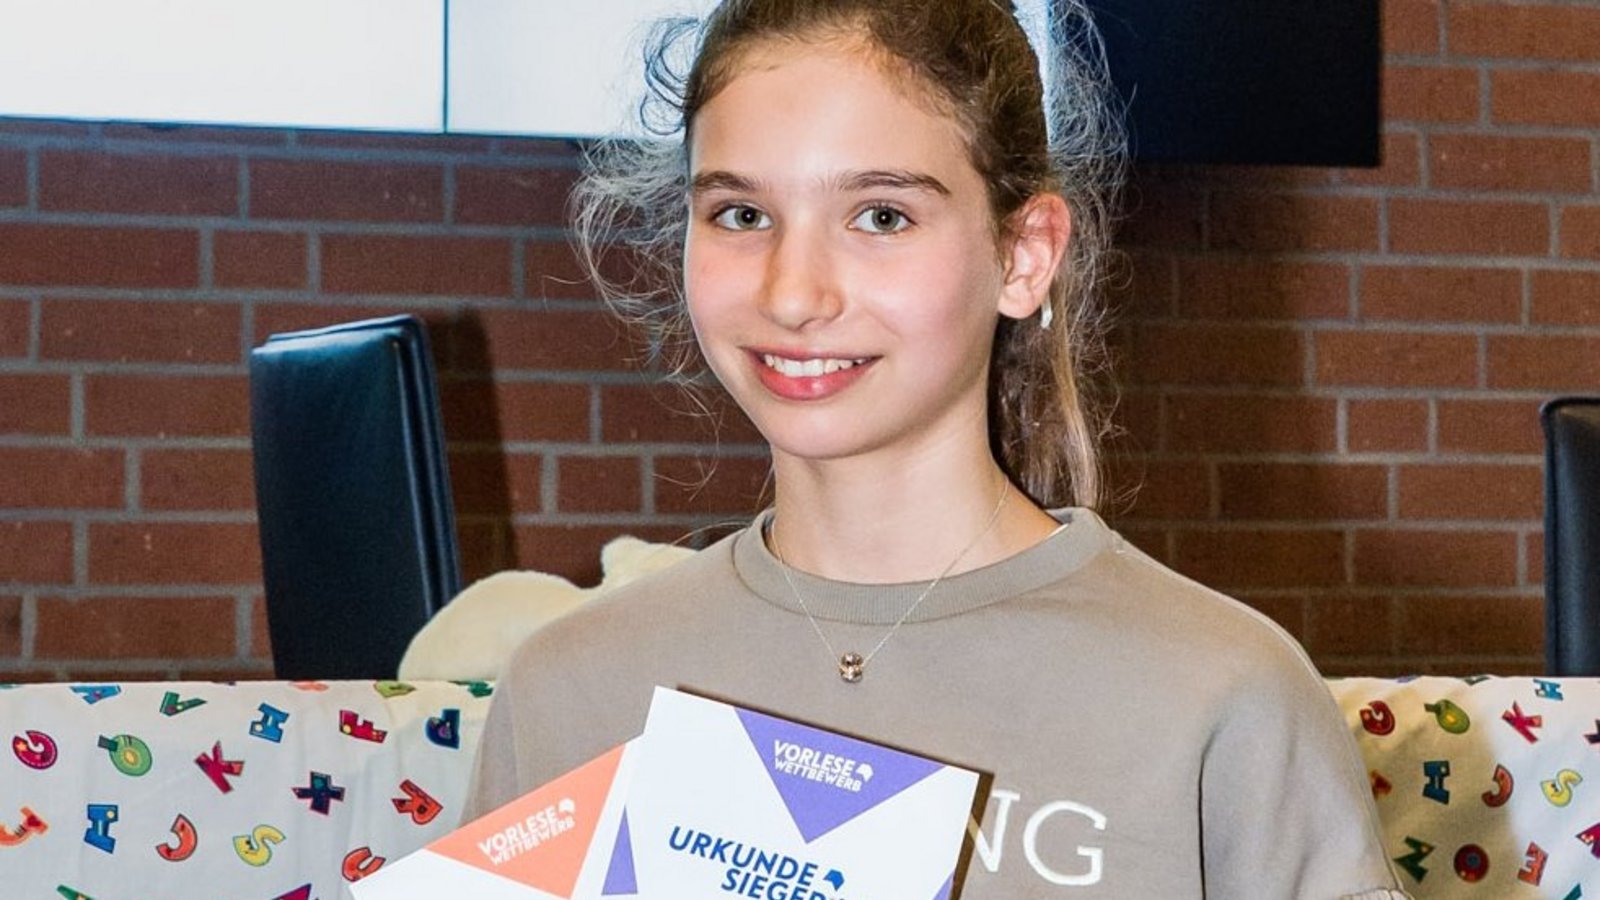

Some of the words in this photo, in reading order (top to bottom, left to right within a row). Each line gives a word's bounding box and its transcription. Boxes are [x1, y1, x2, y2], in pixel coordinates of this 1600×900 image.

[774, 739, 856, 777] VORLESE
[774, 757, 863, 792] WETTBEWERB
[477, 805, 557, 857] VORLESE
[490, 815, 576, 865] WETTBEWERB
[668, 825, 818, 887] URKUNDE
